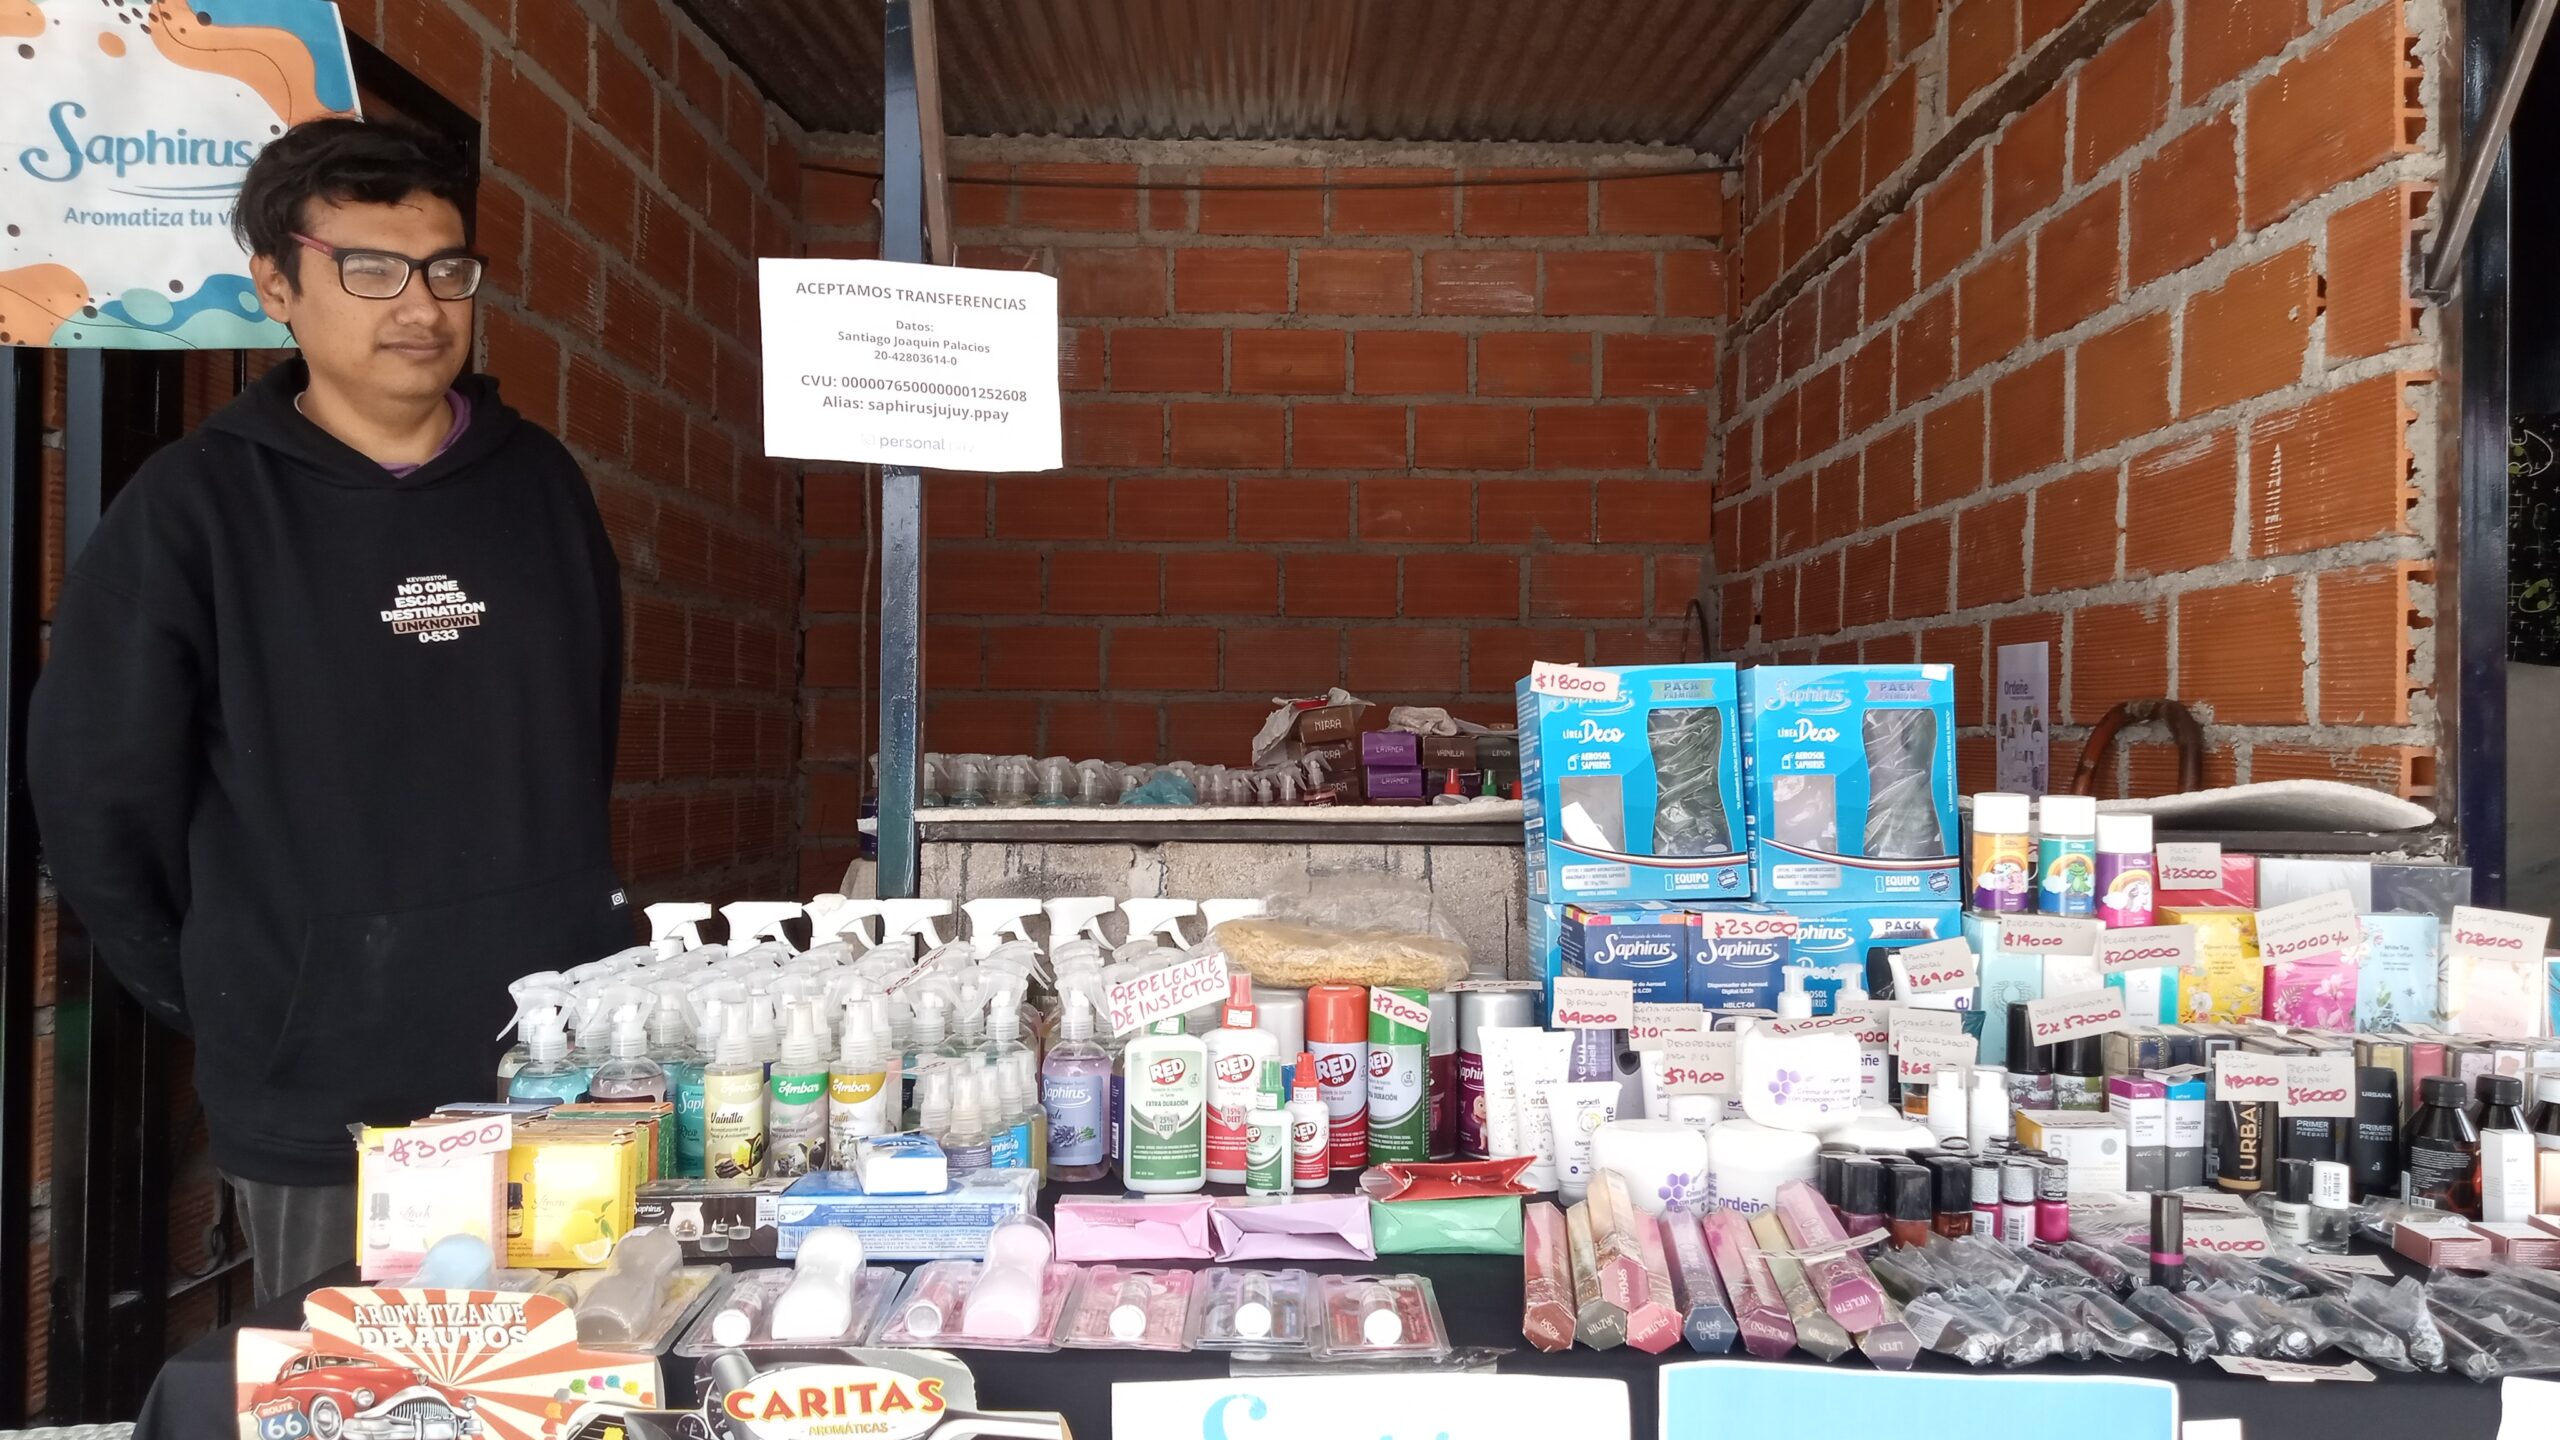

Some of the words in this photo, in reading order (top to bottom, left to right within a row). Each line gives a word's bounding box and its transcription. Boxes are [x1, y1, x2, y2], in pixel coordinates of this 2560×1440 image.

[19, 101, 252, 182] Saphirus
[64, 207, 184, 227] Aromatiza
[189, 208, 212, 227] tu
[796, 282, 892, 300] ACEPTAMOS
[896, 288, 1027, 311] TRANSFERENCIAS
[895, 320, 934, 332] Datos:
[838, 331, 891, 346] Santiago
[893, 335, 940, 350] Joaquin
[943, 340, 990, 354] Palacios
[874, 350, 958, 366] 20-42803614-0
[801, 374, 838, 388] CVU:
[822, 395, 865, 410] Alias:
[868, 400, 1009, 423] saphirusjujuy.ppay
[879, 436, 945, 451] personal
[406, 574, 447, 583] KEVINGSTON
[397, 583, 423, 595] NO
[424, 580, 459, 593] ONE
[394, 591, 467, 608] ESCAPES
[380, 601, 486, 622] DESTINATION
[394, 615, 477, 632] UNKNOWN
[418, 629, 459, 643] 0-533
[1535, 673, 1606, 693] $18000
[1663, 681, 1700, 691] PACK
[1880, 683, 1916, 692] PACK
[1579, 719, 1625, 744] Deco
[1793, 718, 1840, 743] Deco
[1580, 752, 1611, 761] AEROSOL
[1795, 751, 1825, 760] AEROSOL
[1581, 761, 1612, 770] SAPHIRUS
[1795, 760, 1826, 769] SAPHIRUS
[1675, 873, 1709, 884] EQUIPO
[1885, 875, 1920, 886] EQUIPO
[2162, 865, 2217, 880] $25000
[1715, 919, 1798, 938] $25000
[1885, 920, 1922, 930] PACK
[2003, 932, 2063, 948] $19000
[2266, 934, 2329, 958] $20000
[2455, 928, 2523, 949] $28000
[1594, 933, 1672, 965] Saphirus
[1696, 938, 1773, 965] Saphirus
[2104, 948, 2180, 966] $20000
[1109, 957, 1218, 1003] REPELENTE
[1909, 969, 1965, 988] $6900
[1111, 1004, 1138, 1031] DE
[1140, 970, 1226, 1016] INSECTOS
[1375, 994, 1428, 1024] $7000
[1558, 1009, 1617, 1024] $9000
[1772, 1015, 1865, 1034] $10000
[1629, 1025, 1697, 1039] $10
[1215, 1054, 1255, 1080] RED
[1315, 1053, 1357, 1080] RED
[1588, 1044, 1597, 1077] arbell
[1149, 1058, 1186, 1083] RED
[1231, 1073, 1243, 1081] ON
[1663, 1067, 1725, 1086] $7900
[778, 1080, 820, 1096] Ambar
[832, 1078, 871, 1094] Ambar
[1332, 1075, 1345, 1084] ON
[1042, 1079, 1089, 1102] Saphirus
[1374, 1093, 1398, 1101] DURACIÓN
[2287, 1086, 2347, 1106] $6000
[1162, 1099, 1189, 1107] DURACIÓN
[1530, 1095, 1548, 1105] ord
[710, 1111, 743, 1124] Vainilla
[1227, 1107, 1241, 1115] 15%
[1159, 1124, 1174, 1132] DEET
[1294, 1122, 1317, 1139] RED
[2296, 1119, 2329, 1128] PRIMER
[2360, 1123, 2393, 1132] PRIMER
[390, 1123, 503, 1167] $3000
[2240, 1104, 2257, 1170] URBA
[633, 1203, 664, 1217] Saphirus
[1833, 1294, 1872, 1314] VIOLETA
[354, 1303, 527, 1326] AROMATIZANTE
[1540, 1317, 1565, 1339] ROSA
[1586, 1312, 1616, 1337] JAZMIN
[1636, 1316, 1670, 1342] FRUTILLA
[359, 1327, 406, 1349] DE
[409, 1326, 529, 1349] AUTOS
[725, 1377, 947, 1422] CARITAS
[261, 1401, 293, 1416] ROUTE
[267, 1418, 304, 1437] 66
[808, 1421, 889, 1437] AROMÁTICAS
